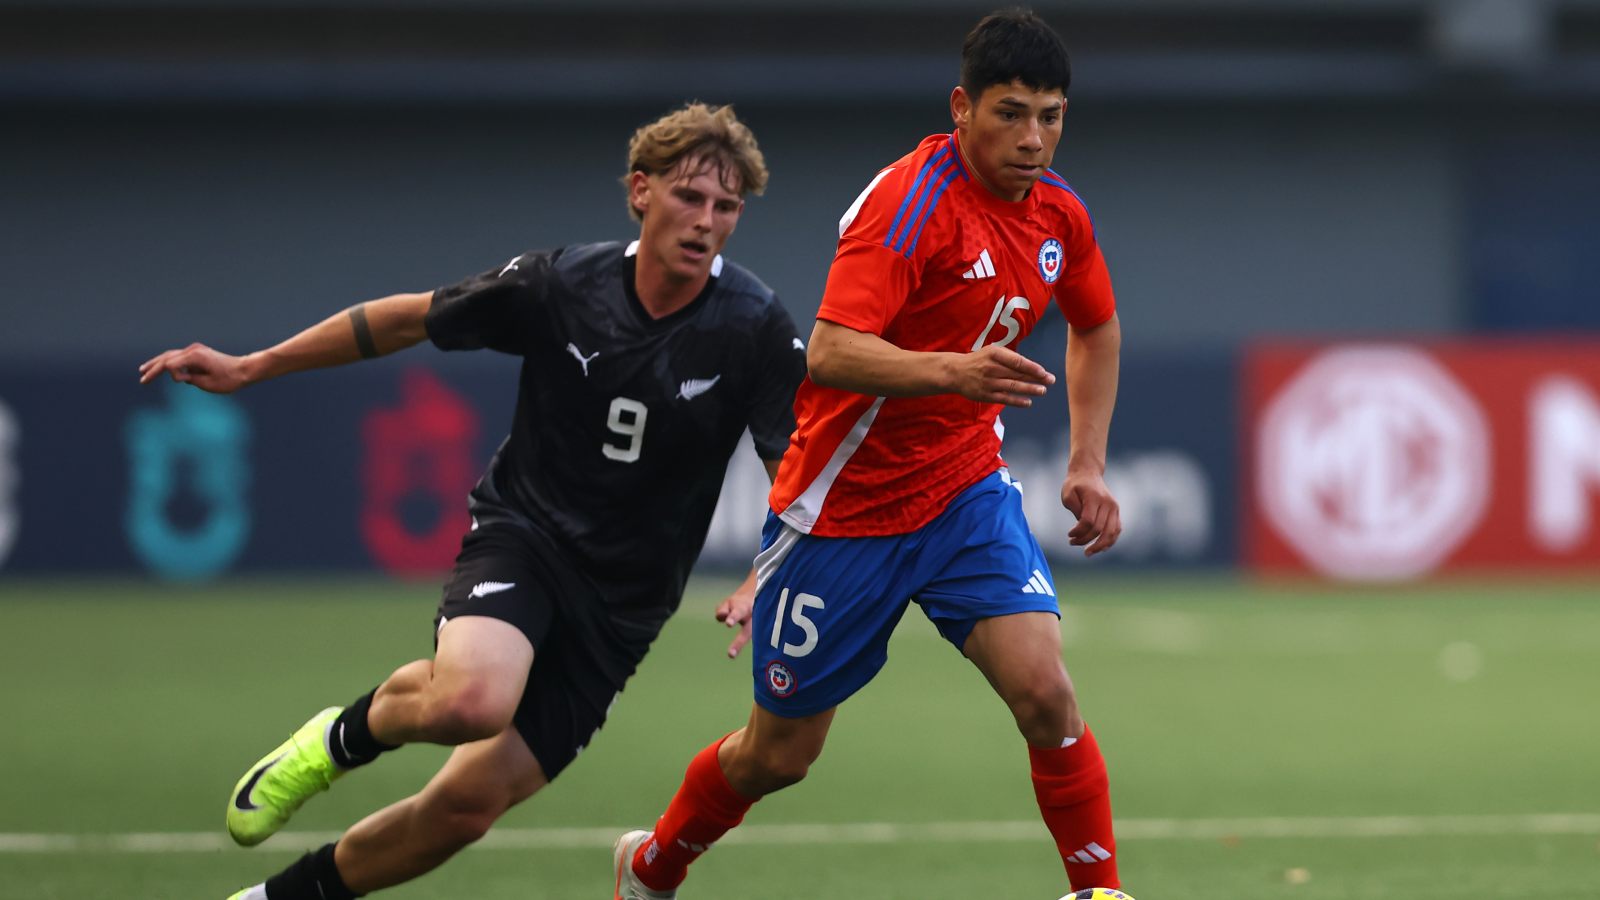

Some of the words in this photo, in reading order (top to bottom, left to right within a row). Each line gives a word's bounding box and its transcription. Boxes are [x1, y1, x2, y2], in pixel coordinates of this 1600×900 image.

[971, 294, 1030, 351] 15
[602, 397, 648, 463] 9
[770, 587, 825, 657] 15
